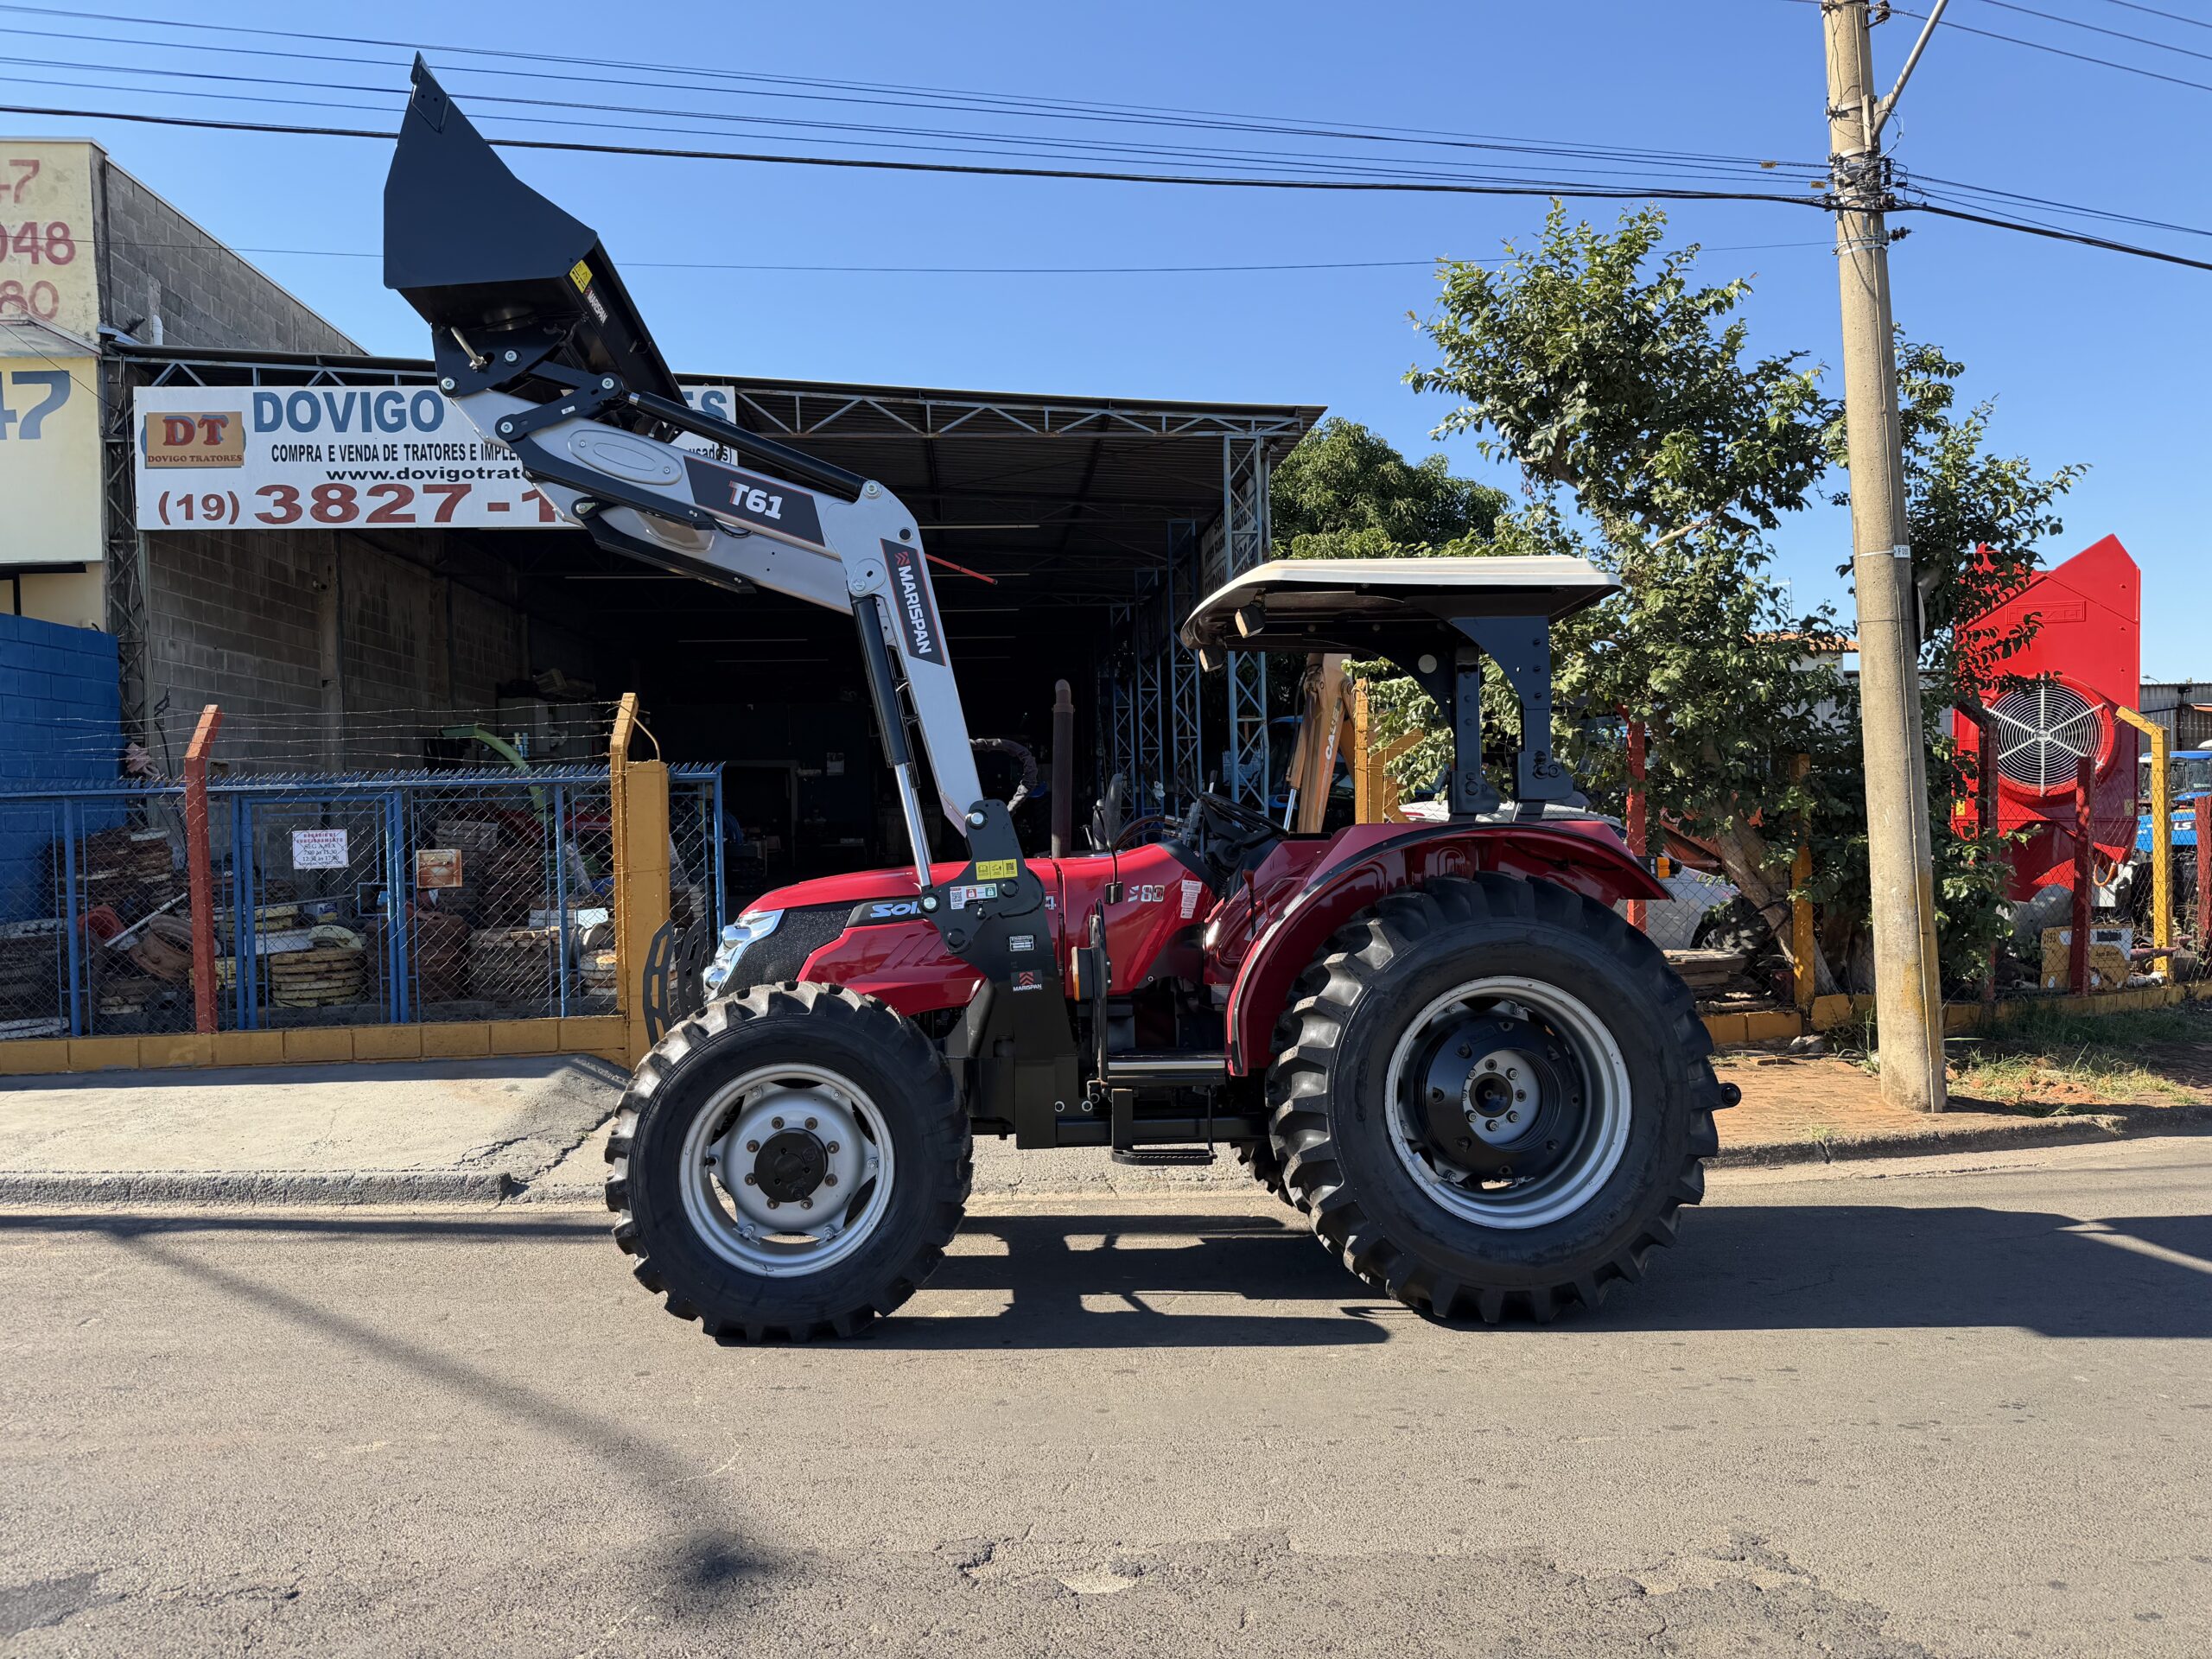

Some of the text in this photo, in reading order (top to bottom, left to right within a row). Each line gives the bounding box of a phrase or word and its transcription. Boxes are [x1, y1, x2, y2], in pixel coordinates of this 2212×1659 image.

[588, 289, 608, 324] MARISPAN
[253, 390, 444, 433] DOVIGO
[162, 414, 229, 446] DT
[271, 442, 520, 462] COMPRA E VENDA DE TRATORES E IMPLE
[158, 491, 240, 525] (19)
[730, 480, 783, 519] T61
[899, 565, 932, 654] MARISPAN
[2174, 822, 2192, 830] LS
[1013, 983, 1042, 992] MARISPAN
